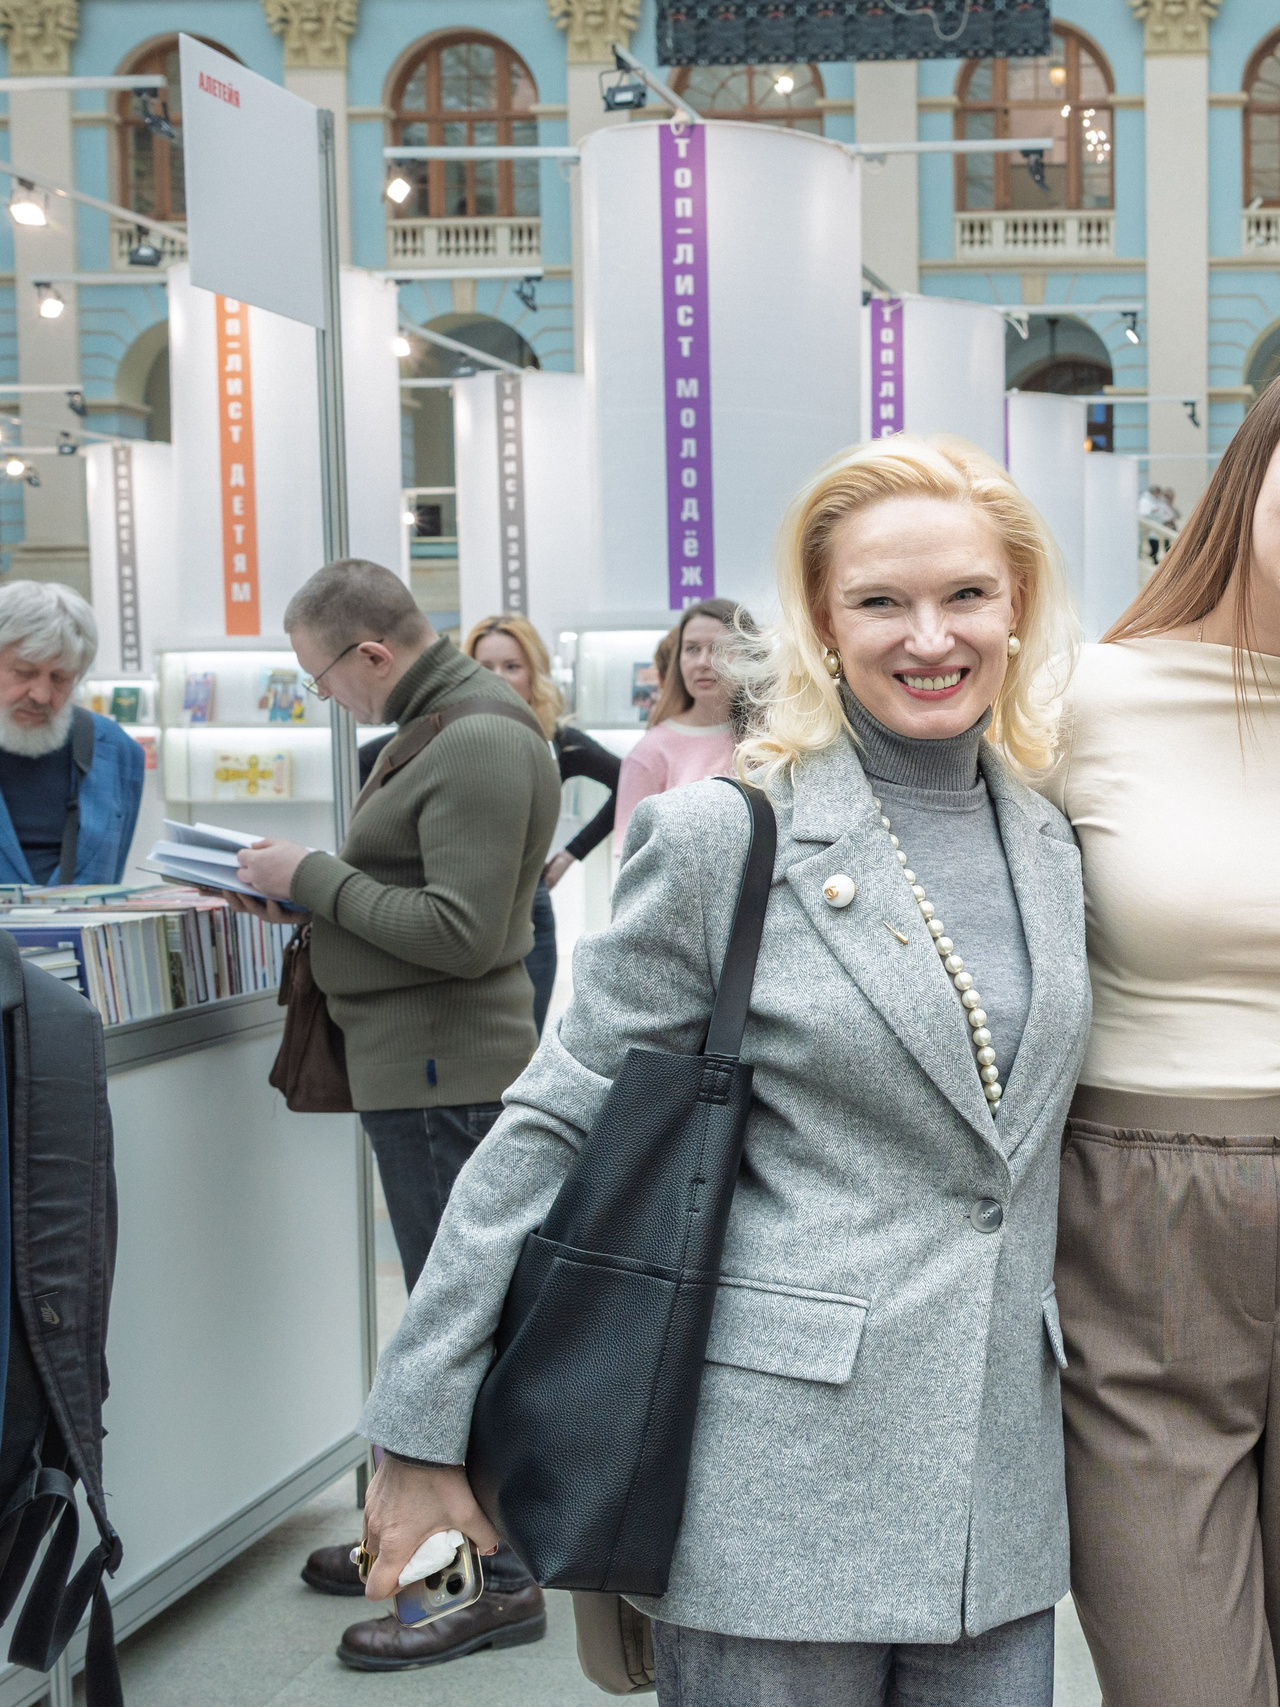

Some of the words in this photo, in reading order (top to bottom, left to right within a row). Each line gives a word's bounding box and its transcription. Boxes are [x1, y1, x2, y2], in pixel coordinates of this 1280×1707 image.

[198, 71, 240, 108] АЛЕТЕЙЯ
[673, 138, 695, 358] ТОП-ЛИСТ
[229, 463, 252, 602] ДЕТЯМ
